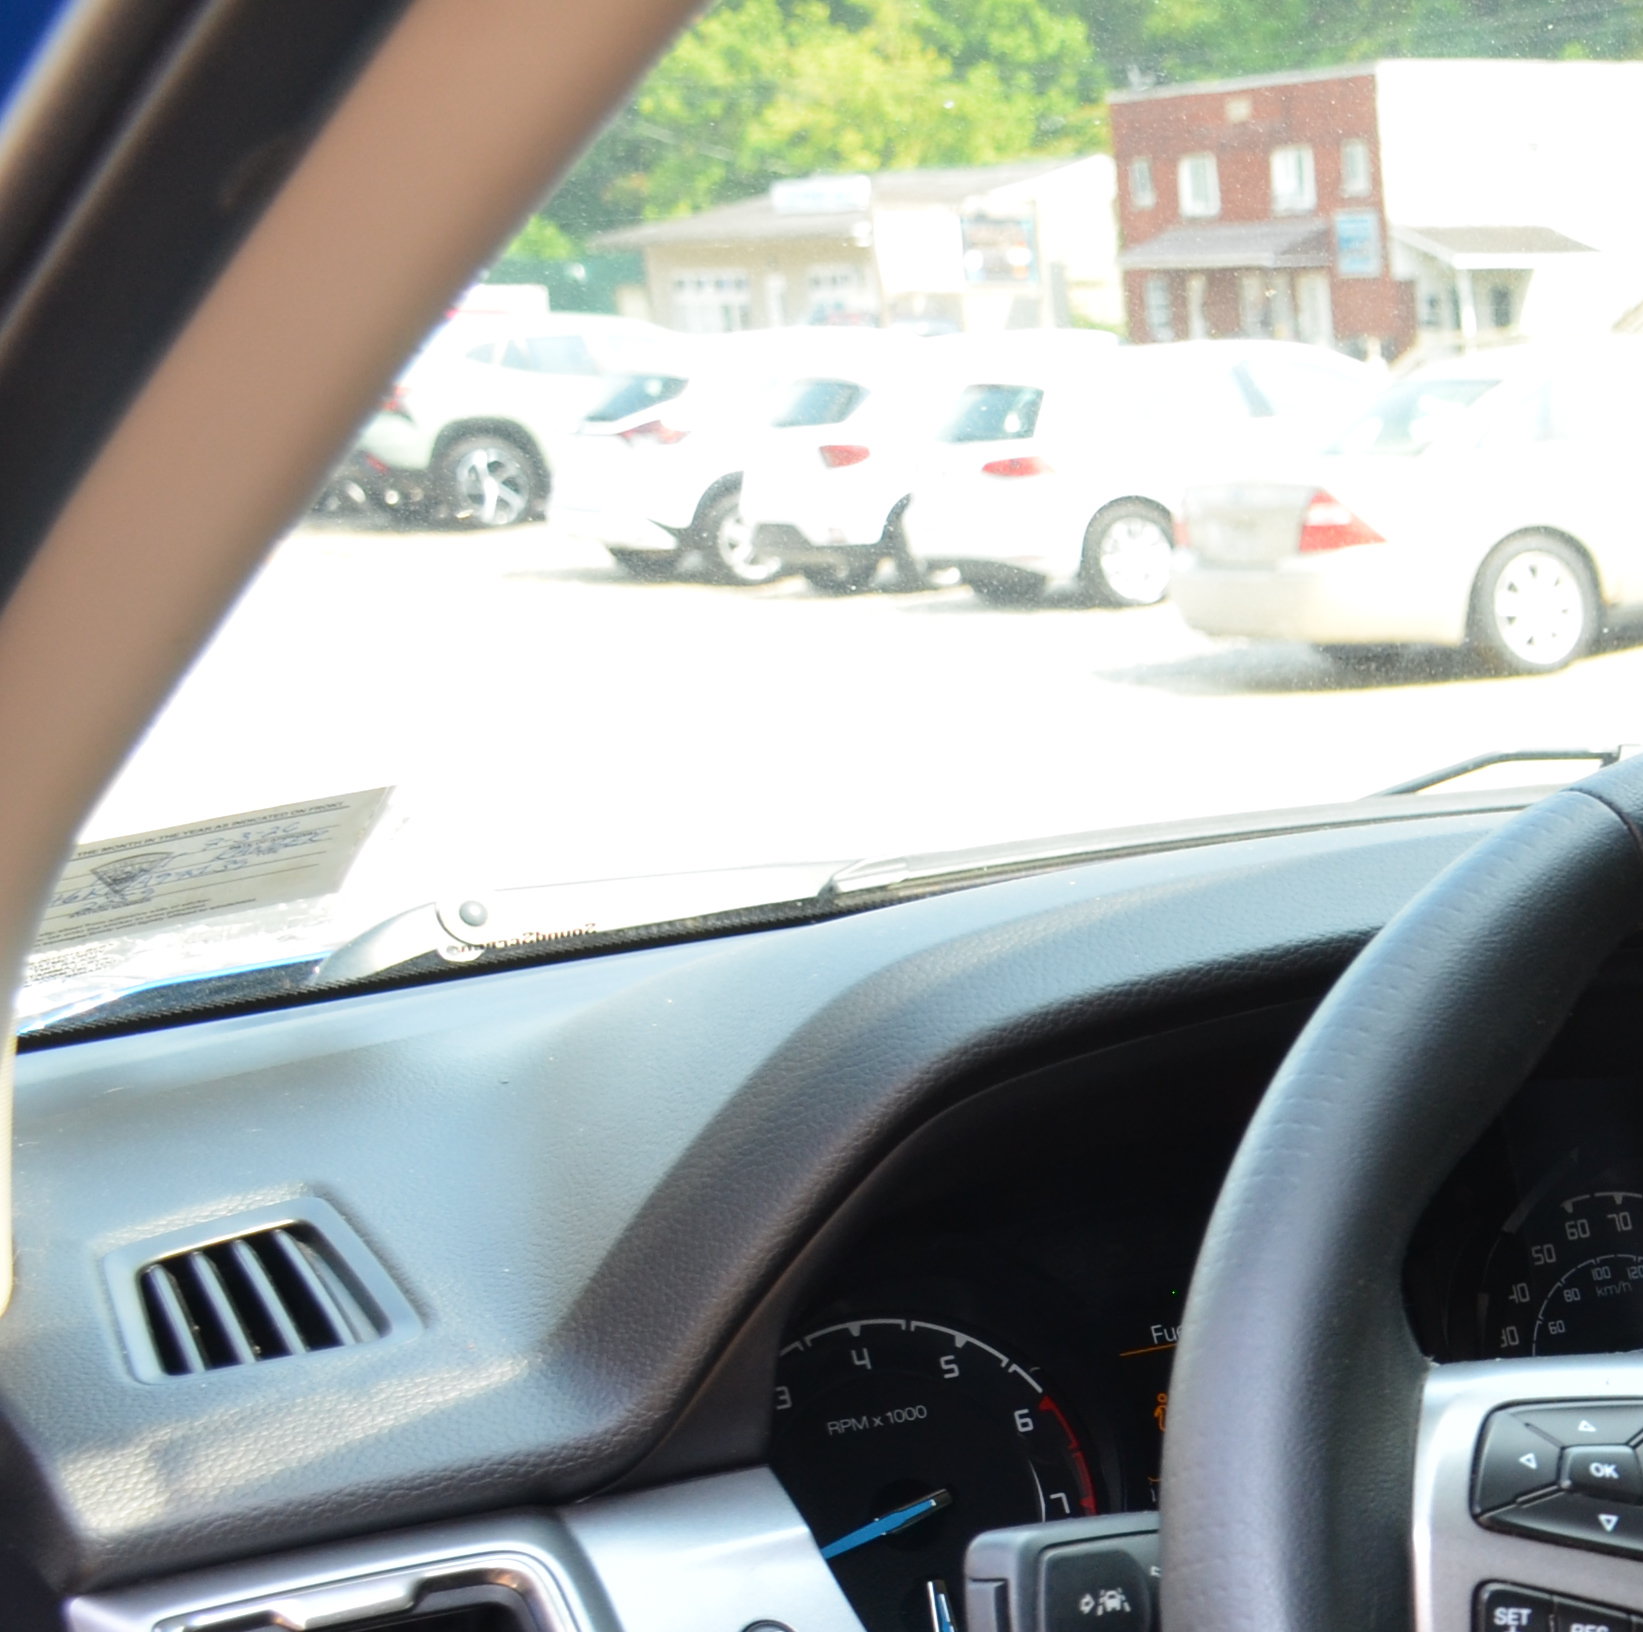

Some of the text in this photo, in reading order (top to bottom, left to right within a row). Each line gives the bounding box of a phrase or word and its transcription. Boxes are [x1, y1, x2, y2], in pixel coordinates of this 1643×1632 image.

[1565, 1219, 1590, 1240] 60
[1607, 1211, 1632, 1232] 70
[1531, 1244, 1556, 1265] 50
[1591, 1266, 1612, 1280] 100
[1563, 1288, 1581, 1302] 80
[1548, 1319, 1566, 1335] 60
[851, 1348, 871, 1369] 4
[940, 1355, 960, 1378] 5
[775, 1385, 793, 1410] 3
[827, 1416, 870, 1436] RPM
[886, 1405, 928, 1425] 1000
[1014, 1409, 1034, 1432] 6
[1589, 1462, 1618, 1480] OK
[1049, 1492, 1071, 1514] 7
[1494, 1608, 1531, 1626] SET
